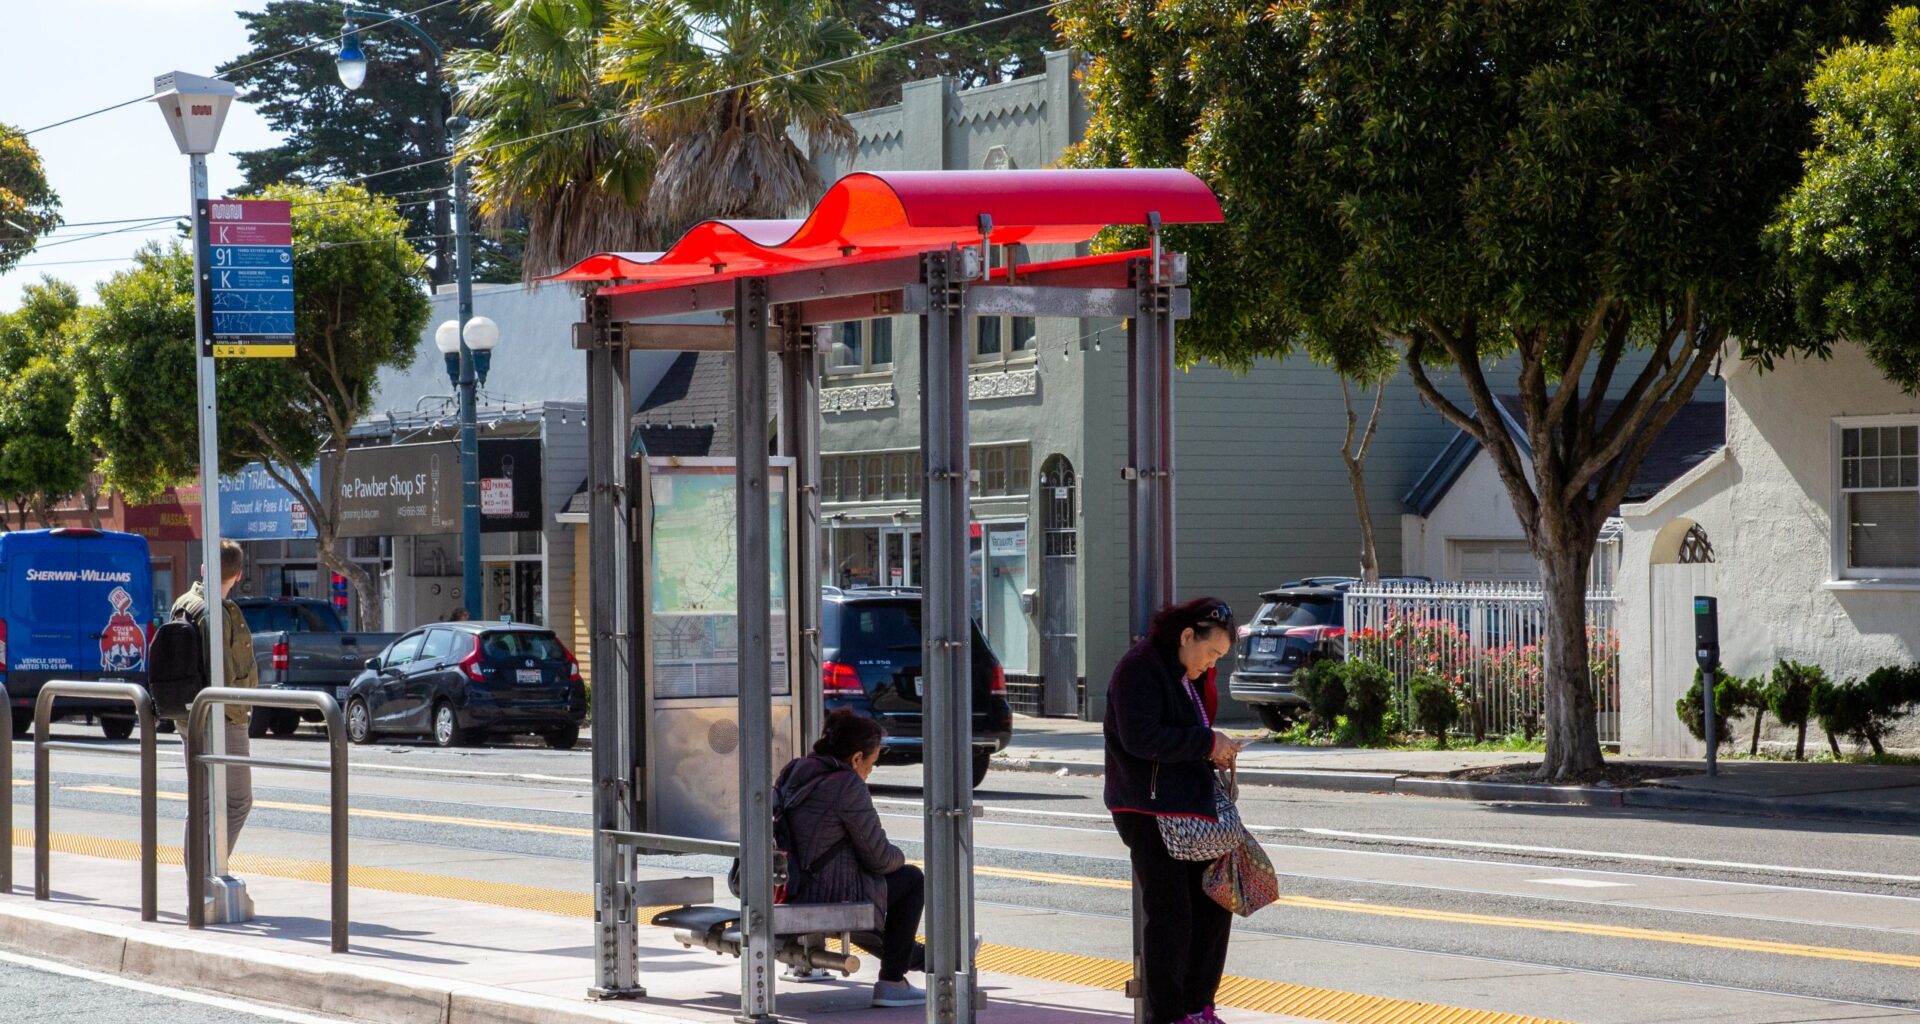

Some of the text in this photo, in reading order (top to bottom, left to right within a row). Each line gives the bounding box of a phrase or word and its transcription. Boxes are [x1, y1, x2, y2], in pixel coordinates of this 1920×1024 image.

[220, 226, 230, 243] K
[216, 248, 232, 266] 91
[221, 270, 231, 288] K
[354, 476, 387, 498] Pawber
[390, 474, 413, 502] Shop
[415, 474, 426, 494] SF
[160, 512, 192, 527] MASSAGE
